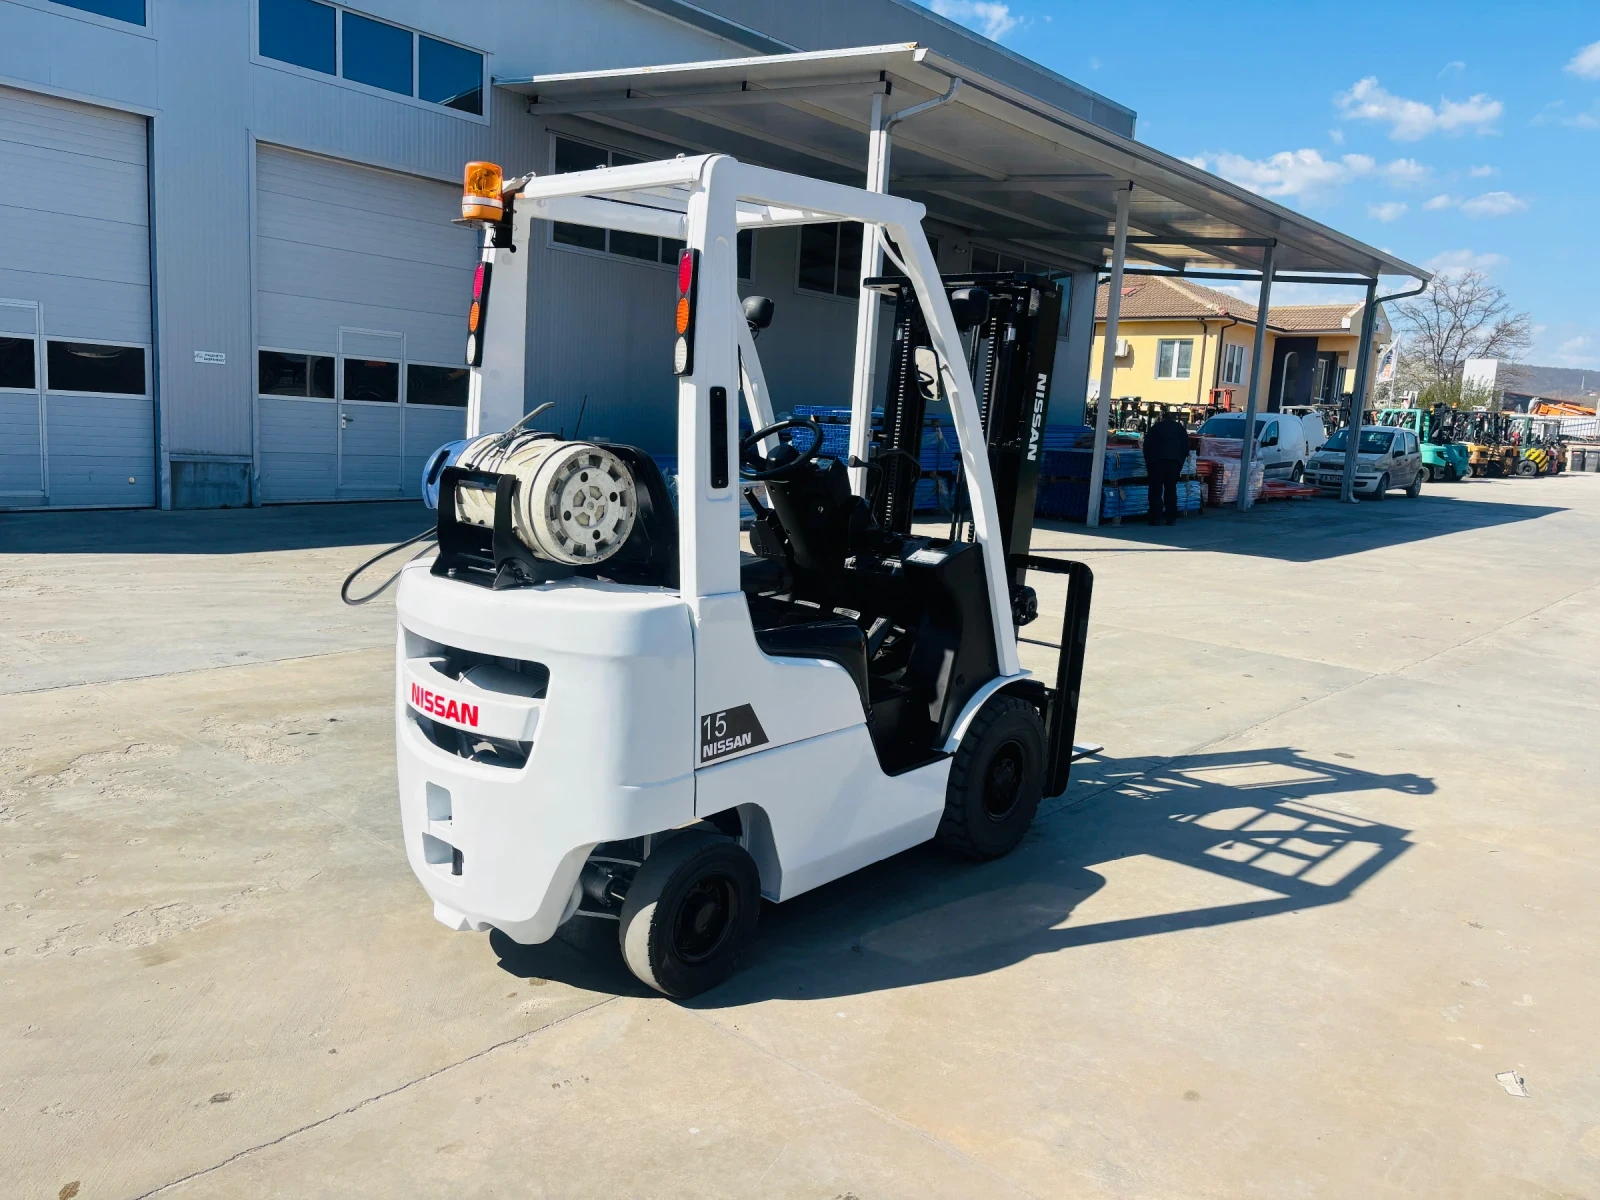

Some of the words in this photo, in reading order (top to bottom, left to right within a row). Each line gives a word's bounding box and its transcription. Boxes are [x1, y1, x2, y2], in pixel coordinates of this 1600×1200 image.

[1026, 372, 1047, 461] NISSAN
[411, 681, 479, 727] NISSAN
[703, 712, 727, 740] 15
[702, 732, 752, 758] NISSAN
